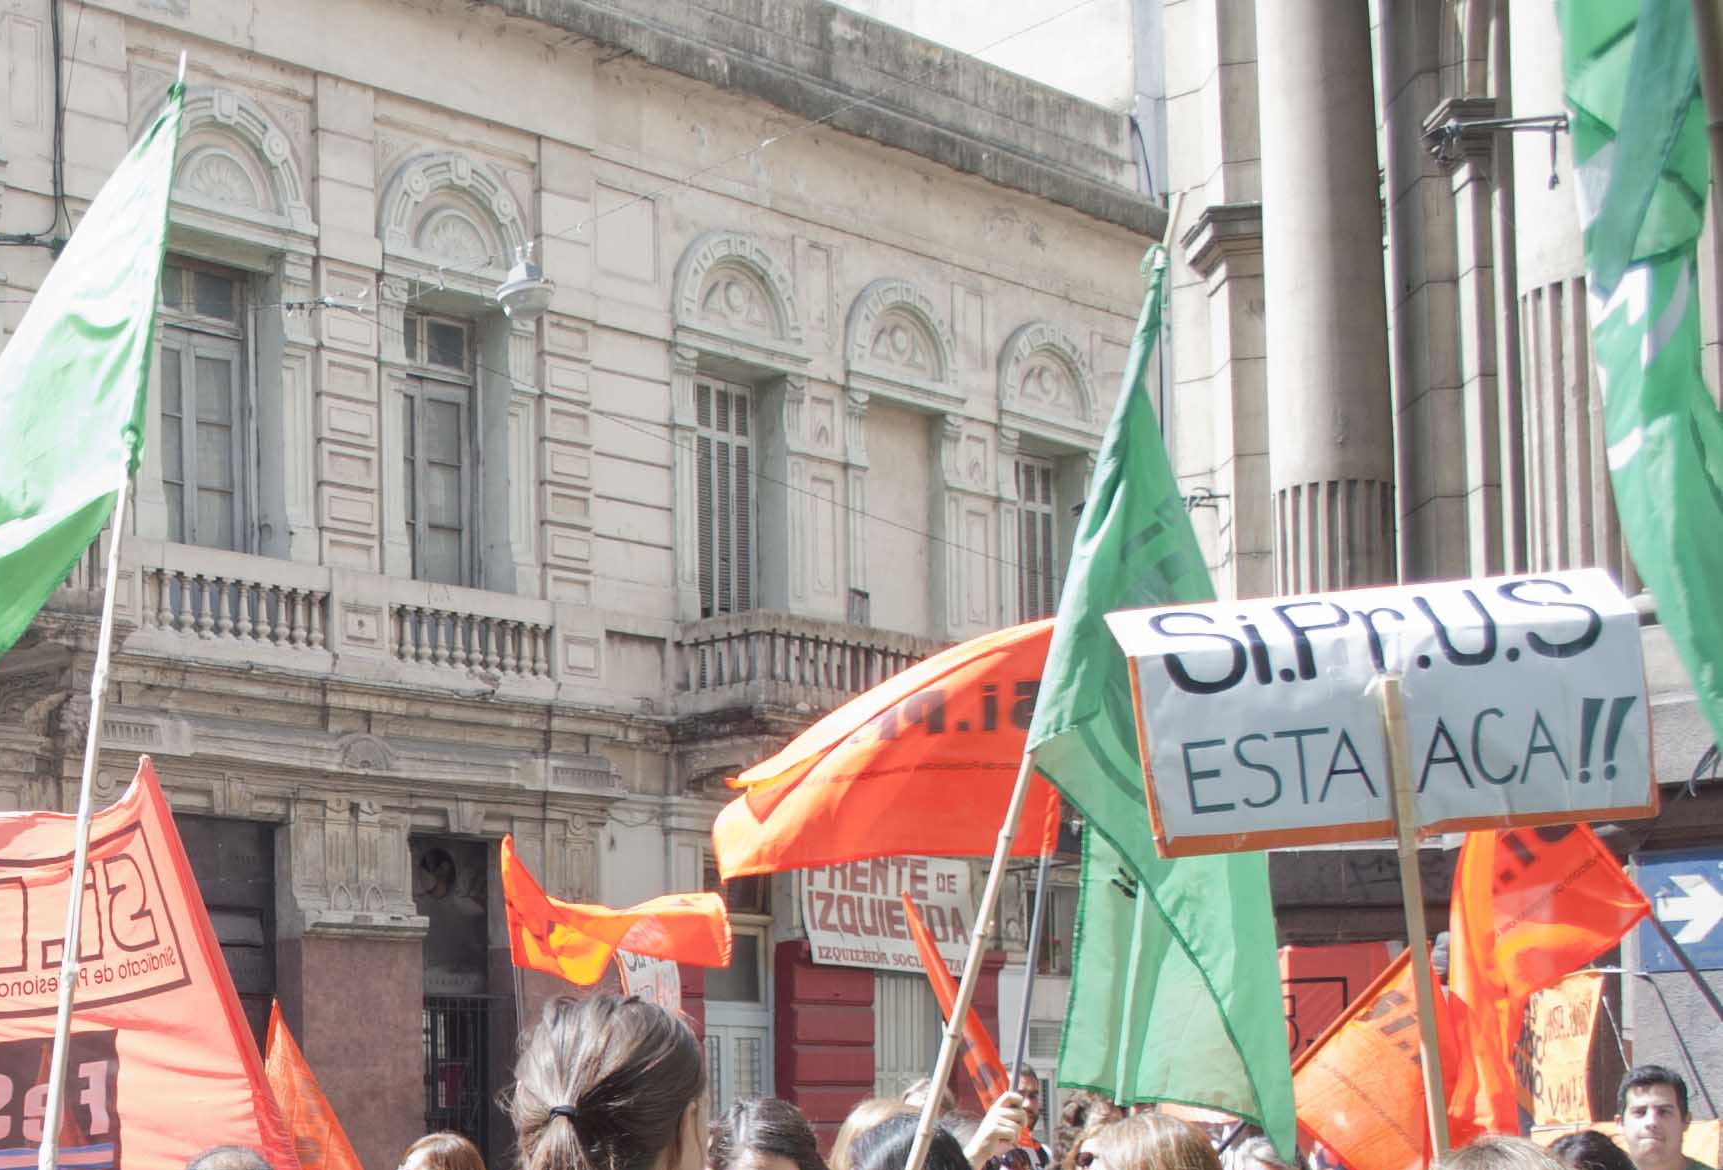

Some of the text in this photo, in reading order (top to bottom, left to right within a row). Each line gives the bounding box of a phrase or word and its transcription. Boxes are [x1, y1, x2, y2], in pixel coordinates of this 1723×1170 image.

[1181, 695, 1638, 815] ESTA ACA!!
[935, 871, 958, 894] DE
